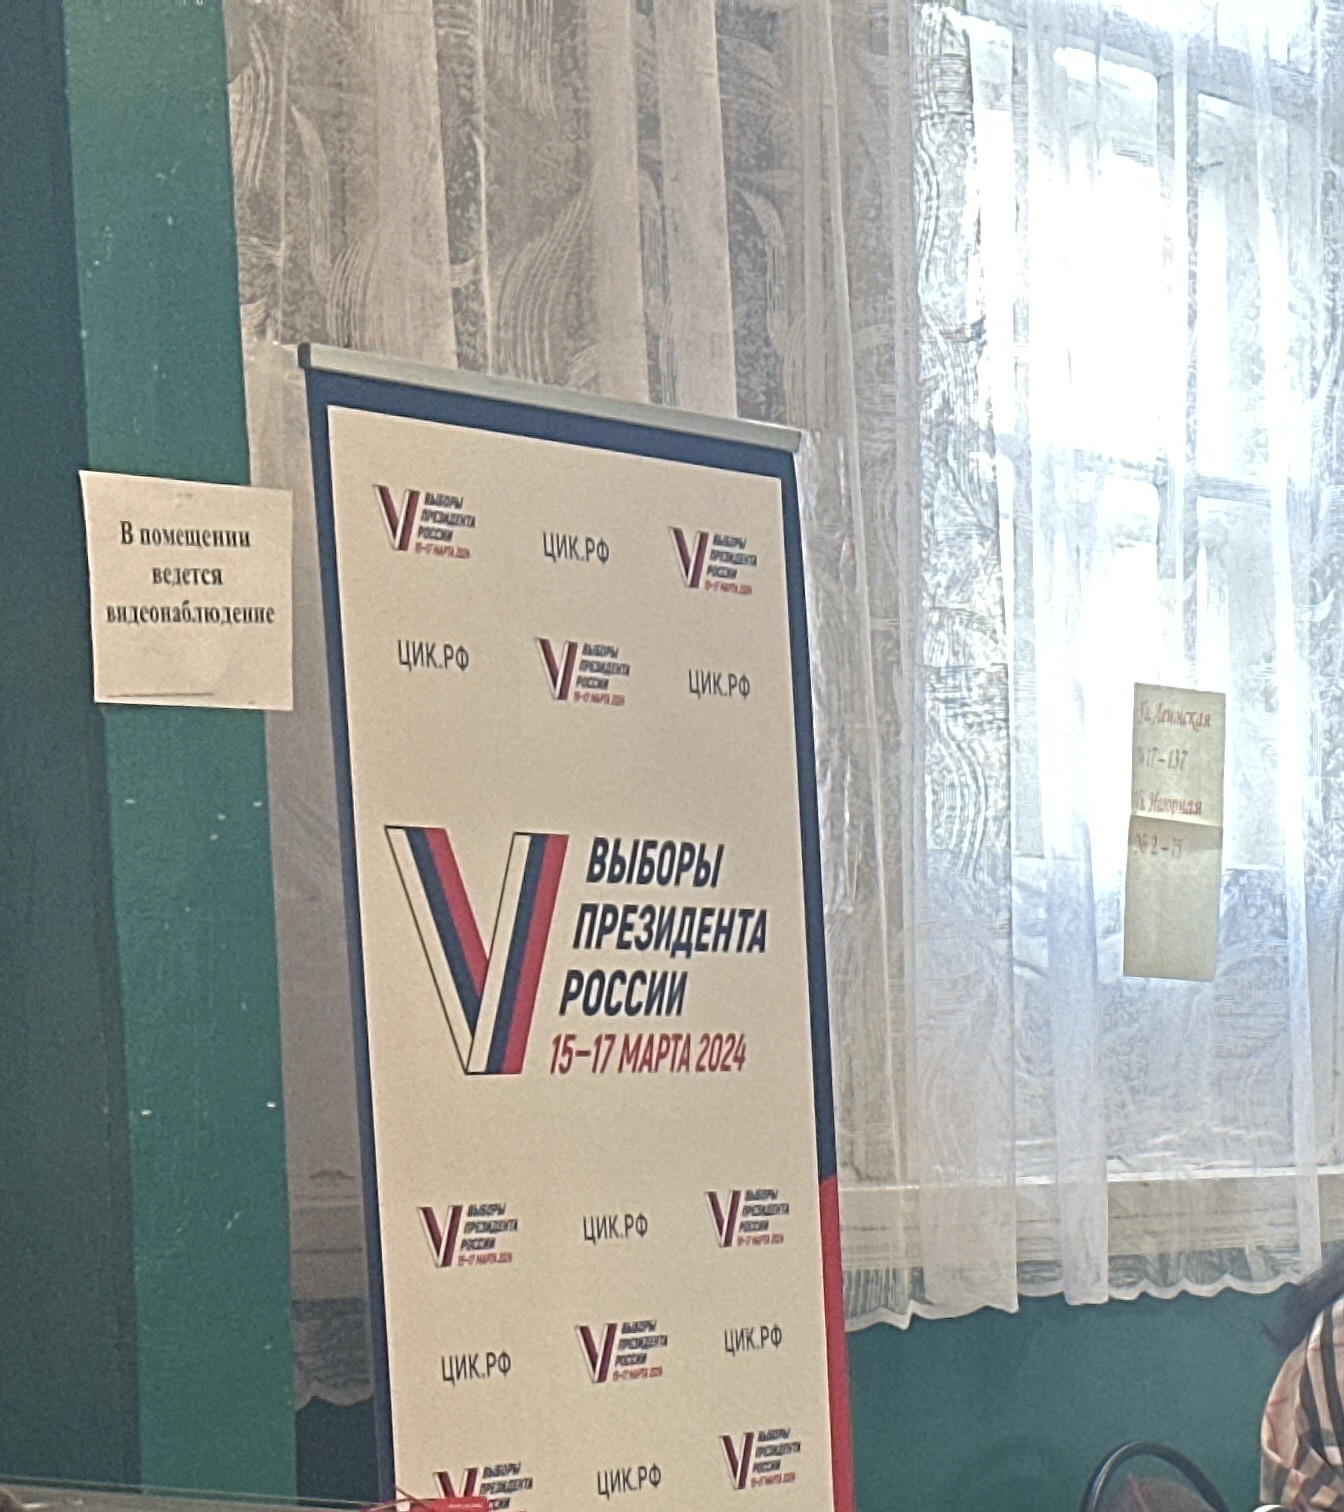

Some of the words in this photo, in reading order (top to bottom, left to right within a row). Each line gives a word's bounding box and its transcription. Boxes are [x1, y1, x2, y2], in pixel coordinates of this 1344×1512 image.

[120, 520, 135, 545] В
[139, 526, 251, 549] помещении
[543, 531, 610, 565] ЦИК.РФ
[152, 565, 224, 587] ведется
[106, 599, 276, 626] видеонаблюдение
[398, 638, 470, 672] ЦИК.РФ
[688, 668, 751, 700] ЦИК.РФ
[586, 836, 725, 888] ВЫБОРЫ
[572, 903, 768, 959] ПРЕЗИДЕНТА
[559, 969, 689, 1017] РОССИИ
[618, 1033, 692, 1074] МАРТА
[695, 1033, 747, 1073] 2024
[583, 1213, 649, 1246] ЦИК.РФ
[724, 1322, 782, 1358] ЦИК.РФ
[442, 1350, 512, 1387] ЦИК.РФ
[597, 1462, 662, 1501] ЦИК.РФ
